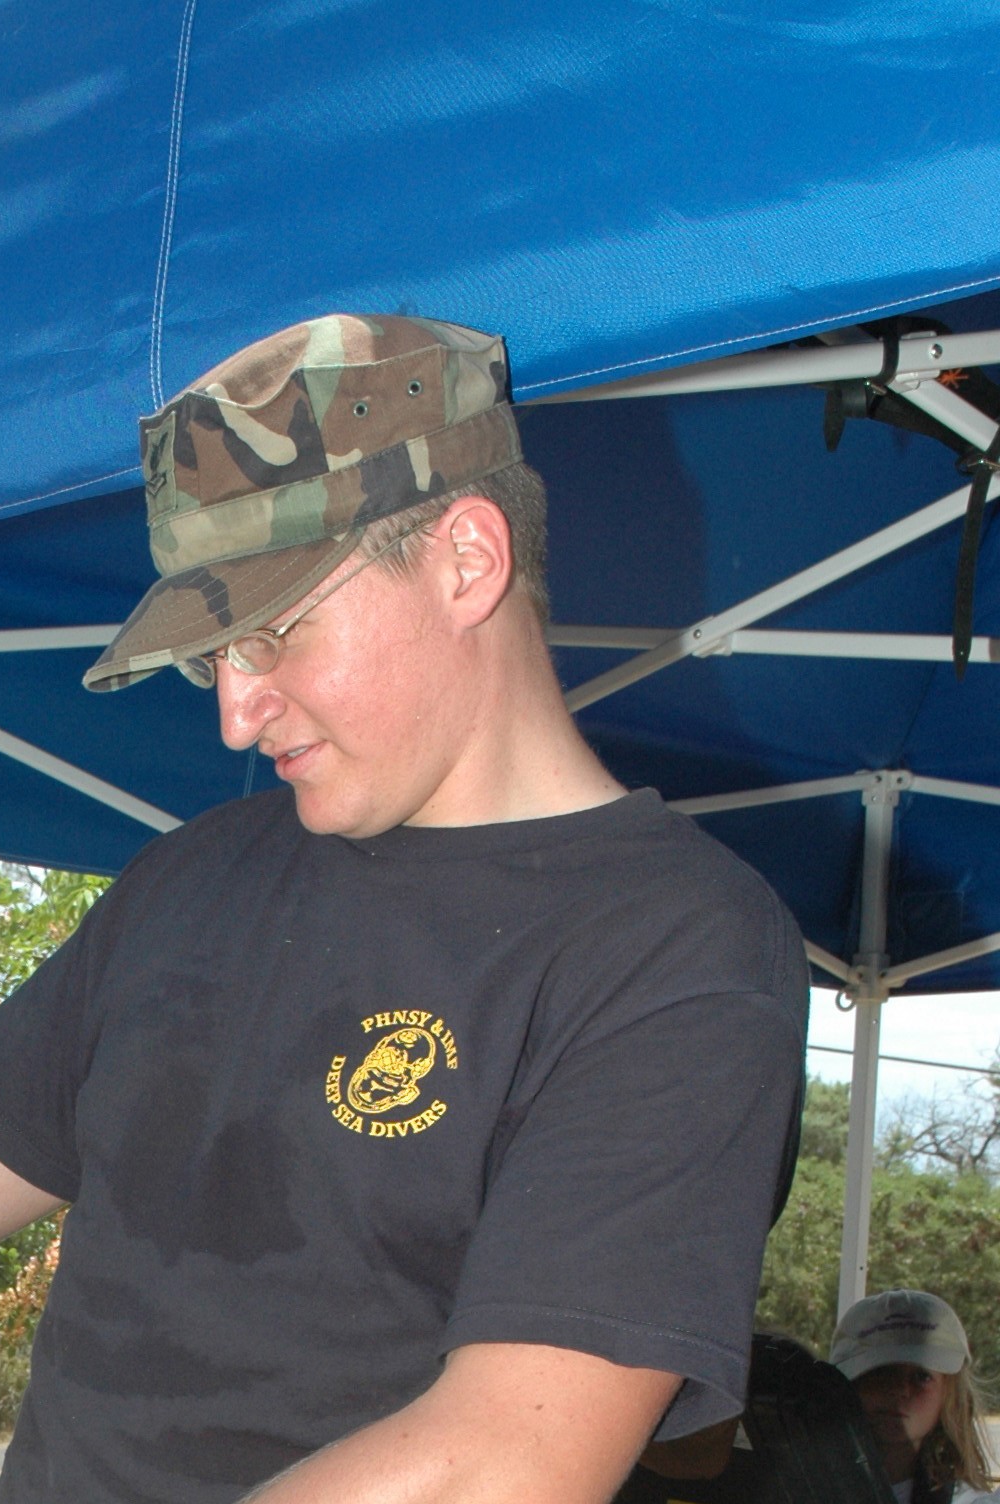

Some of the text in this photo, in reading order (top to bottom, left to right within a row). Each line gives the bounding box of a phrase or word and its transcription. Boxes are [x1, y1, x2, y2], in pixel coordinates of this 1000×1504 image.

[360, 1009, 433, 1034] PHNSY
[430, 1018, 445, 1037] &
[326, 1054, 448, 1138] DEEP SEA DIVERS
